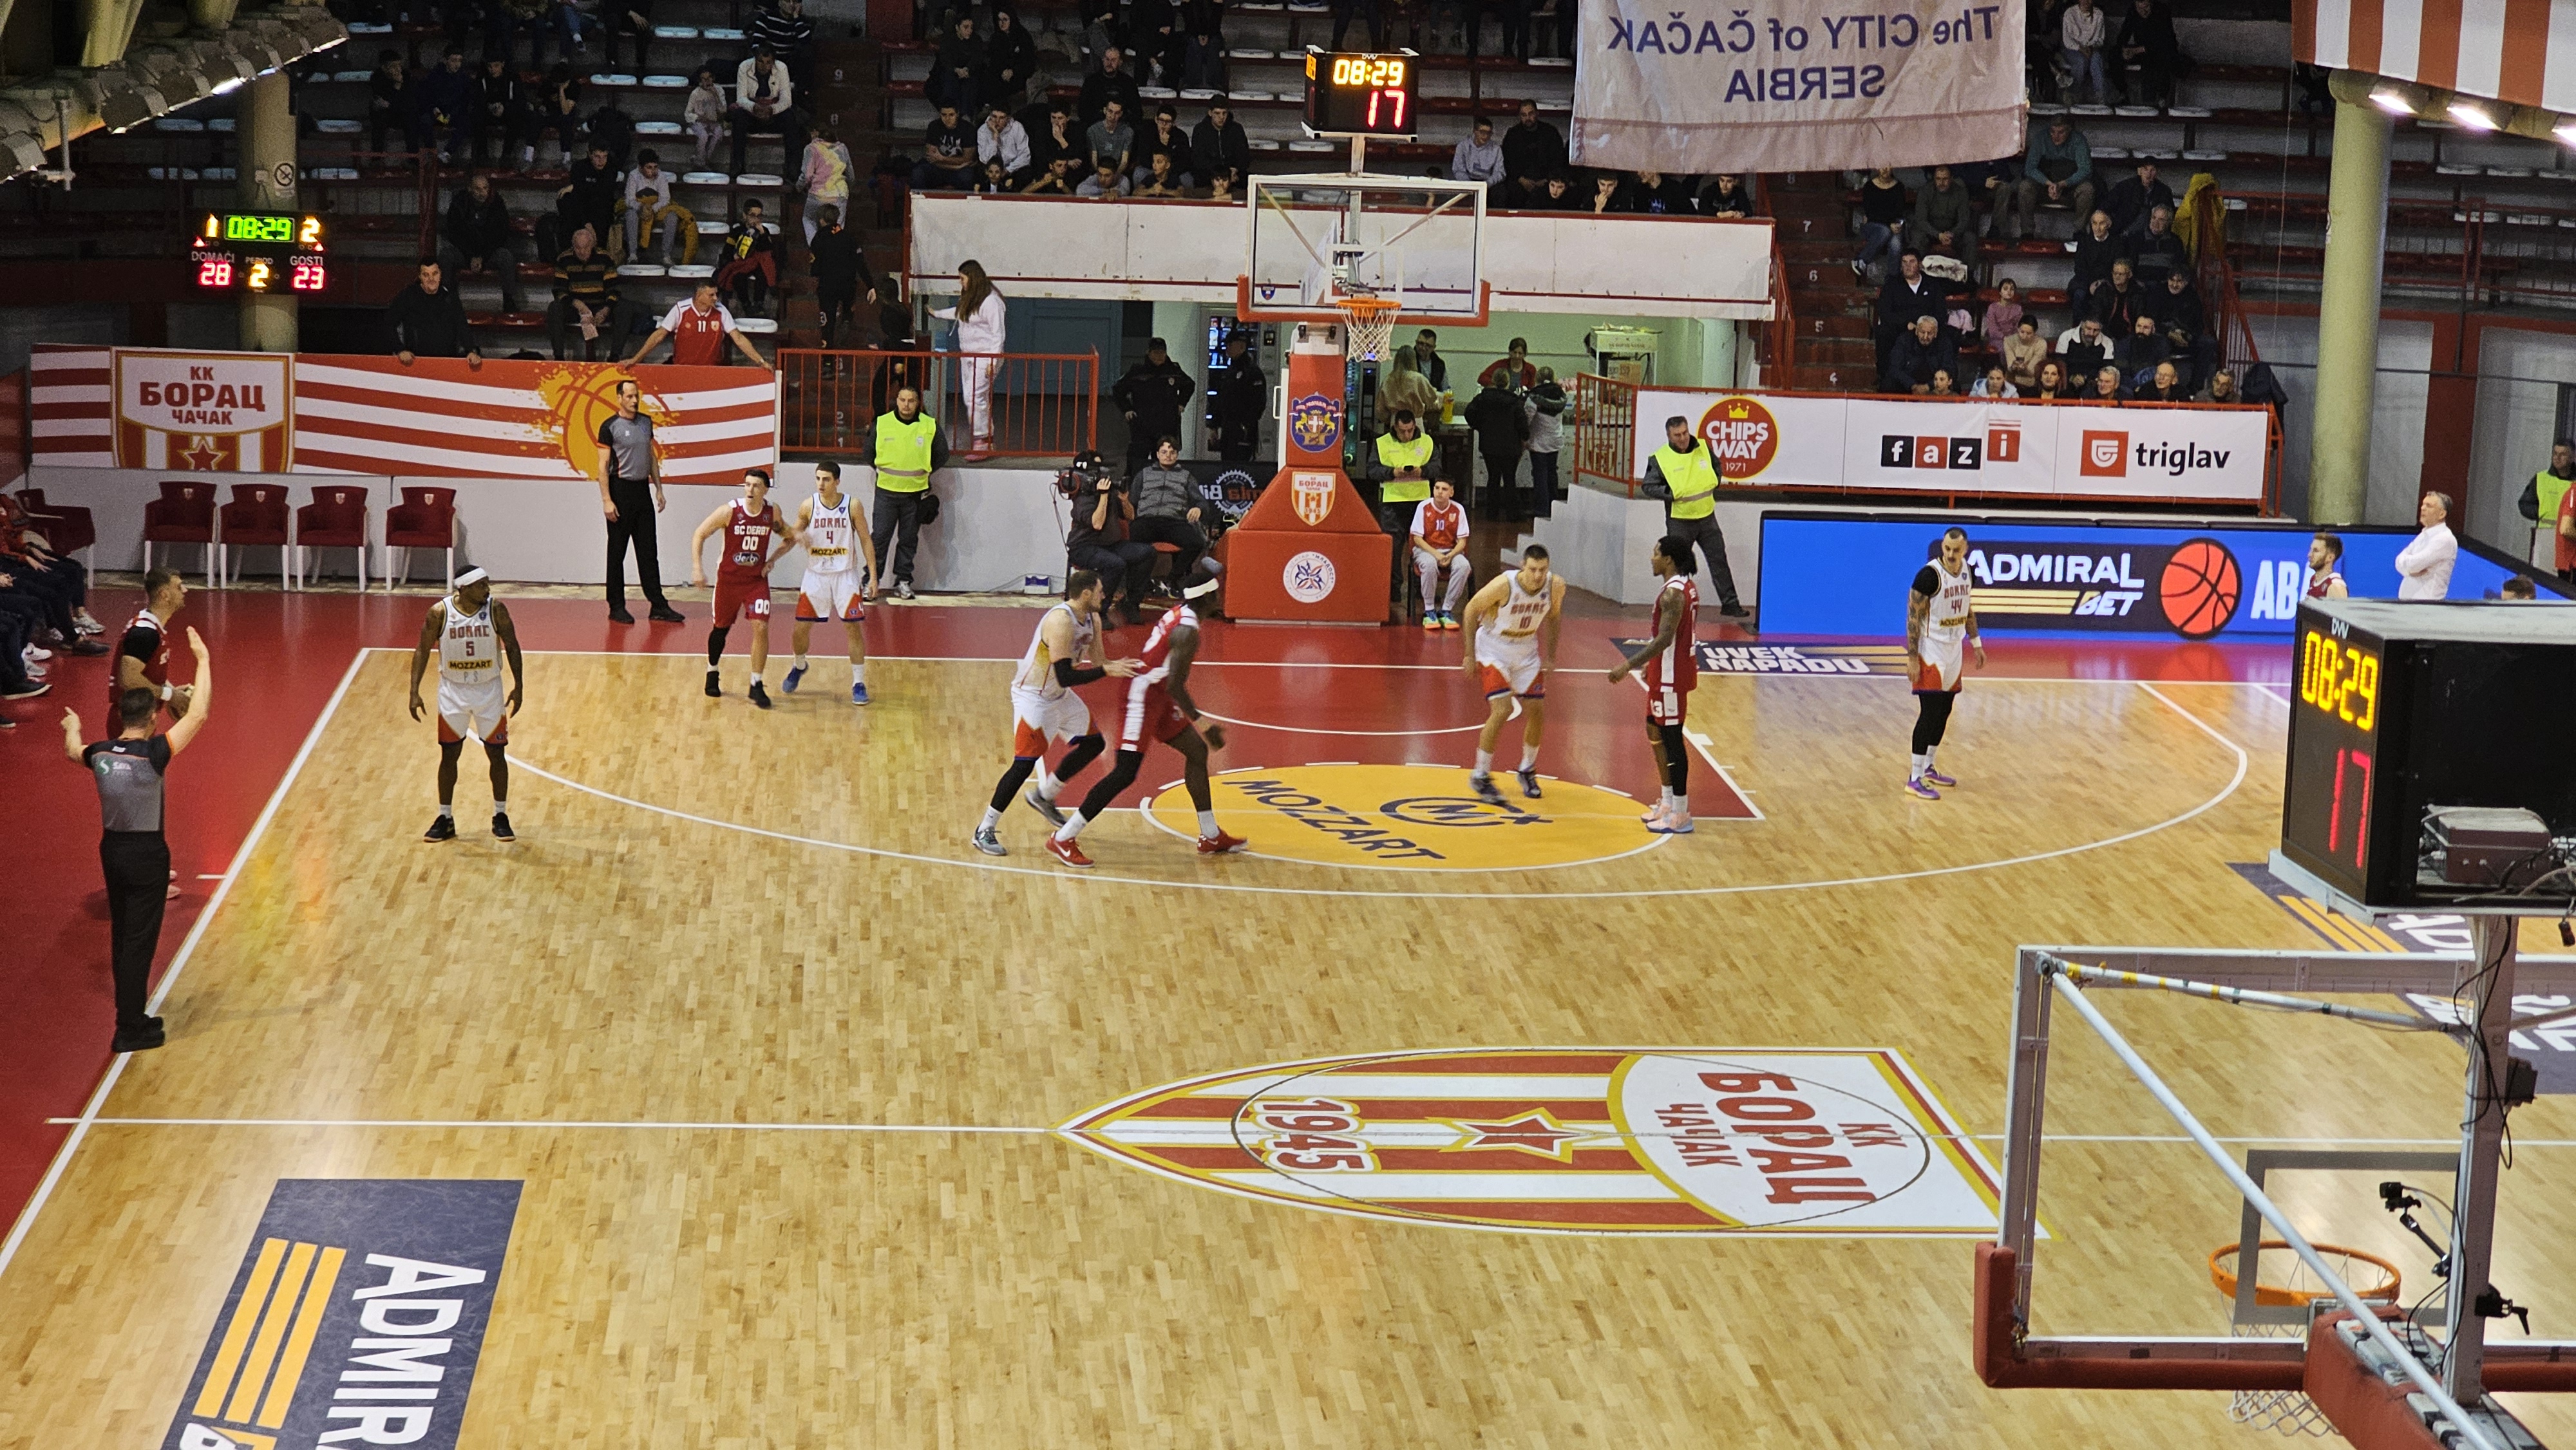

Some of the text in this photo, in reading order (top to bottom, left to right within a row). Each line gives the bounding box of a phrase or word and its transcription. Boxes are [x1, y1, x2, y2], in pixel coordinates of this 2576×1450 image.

[1332, 59, 1405, 86] 08:29
[1367, 89, 1406, 128] 17
[227, 216, 293, 240] 08:29
[299, 215, 321, 243] 2
[1803, 220, 1812, 232] 7
[198, 261, 232, 287] 28
[290, 256, 323, 267] GOSTI
[249, 262, 270, 287] 2
[292, 264, 325, 290] 23
[1809, 270, 1818, 282] 6
[697, 320, 706, 332] 11
[1815, 320, 1824, 332] 5
[190, 366, 214, 381] КК
[140, 381, 265, 412] БОРАЦ
[172, 409, 233, 425] ЧАЧАК
[1706, 420, 1768, 441] CHIPS
[1711, 440, 1763, 459] WAY
[1890, 433, 2009, 466] fazi
[2136, 442, 2231, 476] triglav
[1726, 462, 1746, 473] 1971
[742, 536, 759, 551] 00
[826, 530, 834, 544] 4
[1967, 550, 2145, 588] ADMIRAL
[754, 598, 770, 615] 00
[2075, 591, 2143, 616] BET
[466, 641, 475, 656] 5
[1703, 646, 1806, 659] UVEK
[450, 659, 491, 670] MOZZART
[1706, 658, 1870, 673] NAPADU
[2302, 630, 2378, 732] 08:29
[1222, 780, 1446, 860] MOZZART
[2329, 748, 2371, 869] 17
[1256, 1097, 1370, 1172] 1945
[1654, 1104, 1742, 1167] ЧАЧАК
[1698, 1072, 1877, 1204] БОРАЦ
[1837, 1123, 1908, 1148] КК
[316, 1253, 487, 1450] ADMIR
